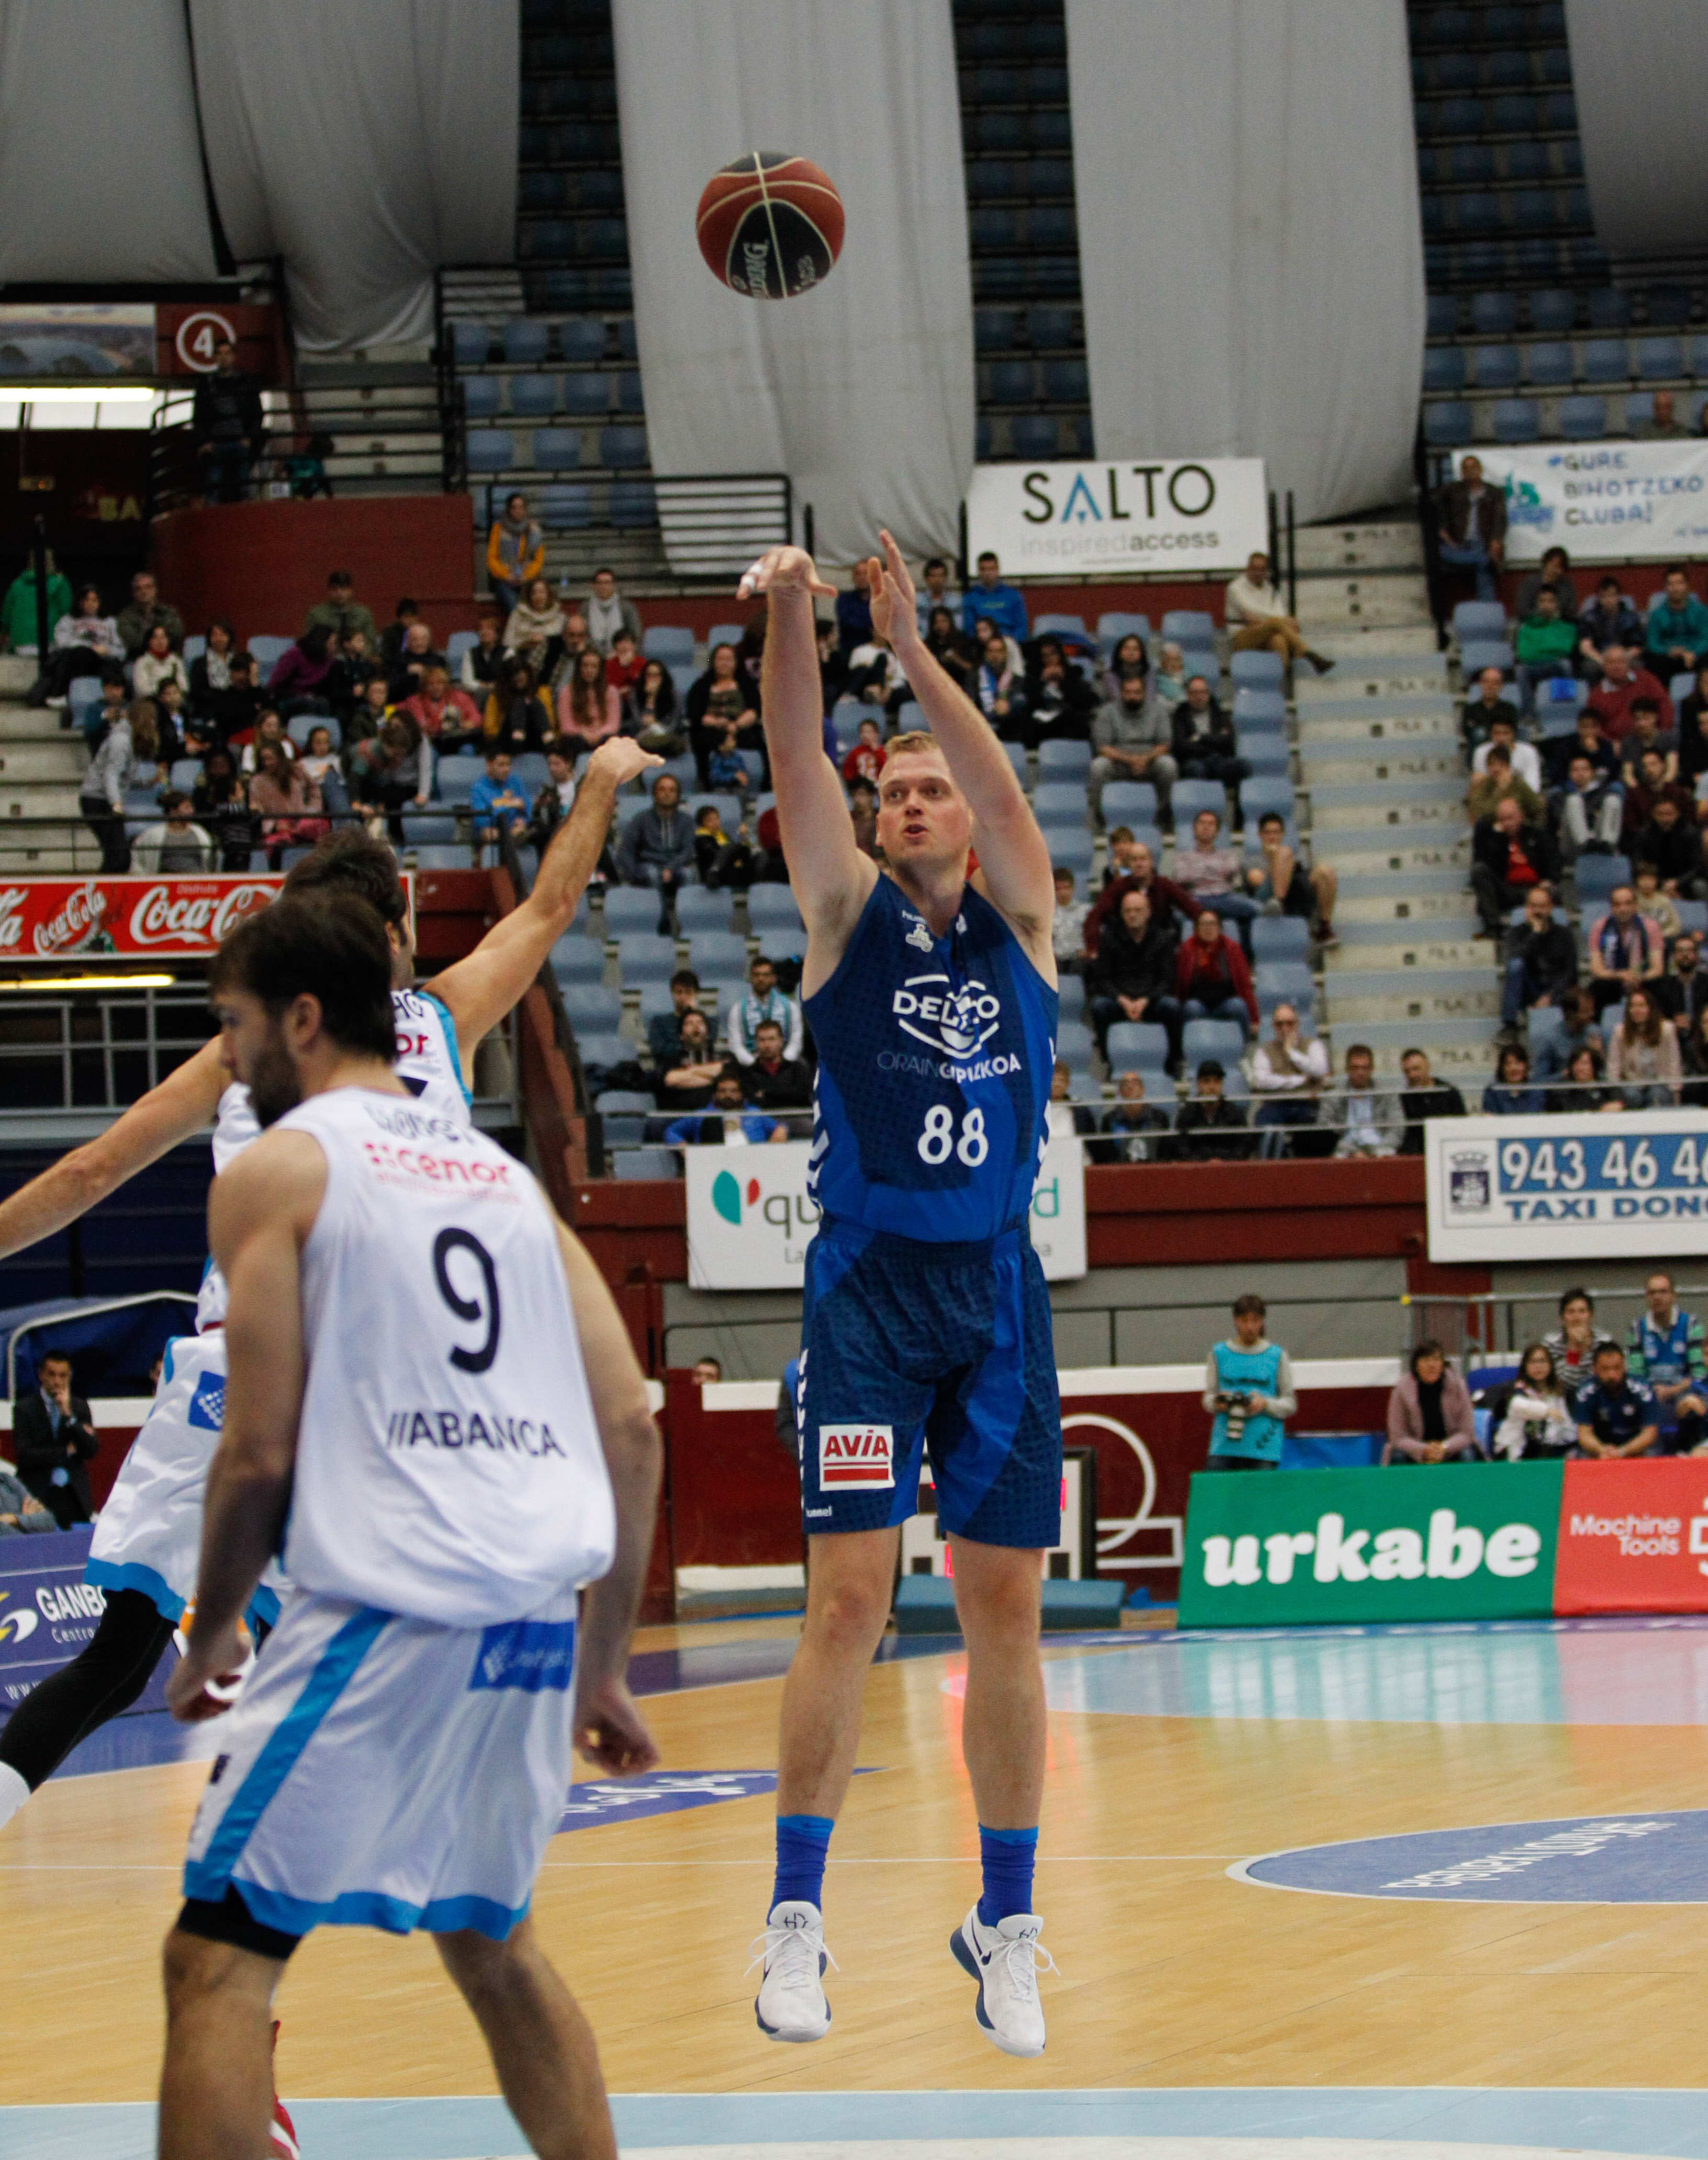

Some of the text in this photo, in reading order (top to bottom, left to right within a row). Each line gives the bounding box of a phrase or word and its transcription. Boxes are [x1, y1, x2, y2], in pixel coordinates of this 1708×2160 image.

[193, 326, 215, 358] 4
[1022, 464, 1216, 523] SALTO
[917, 1104, 989, 1167] 88
[398, 1149, 510, 1186] cenor
[1502, 1141, 1586, 1190] 943
[1601, 1139, 1658, 1189] 46
[1505, 1198, 1596, 1221] TAXI
[433, 1227, 500, 1375] 9
[824, 1429, 889, 1458] AVIA
[1570, 1513, 1681, 1536] Machine
[1201, 1508, 1542, 1587] urkabe
[1618, 1535, 1680, 1556] Tools
